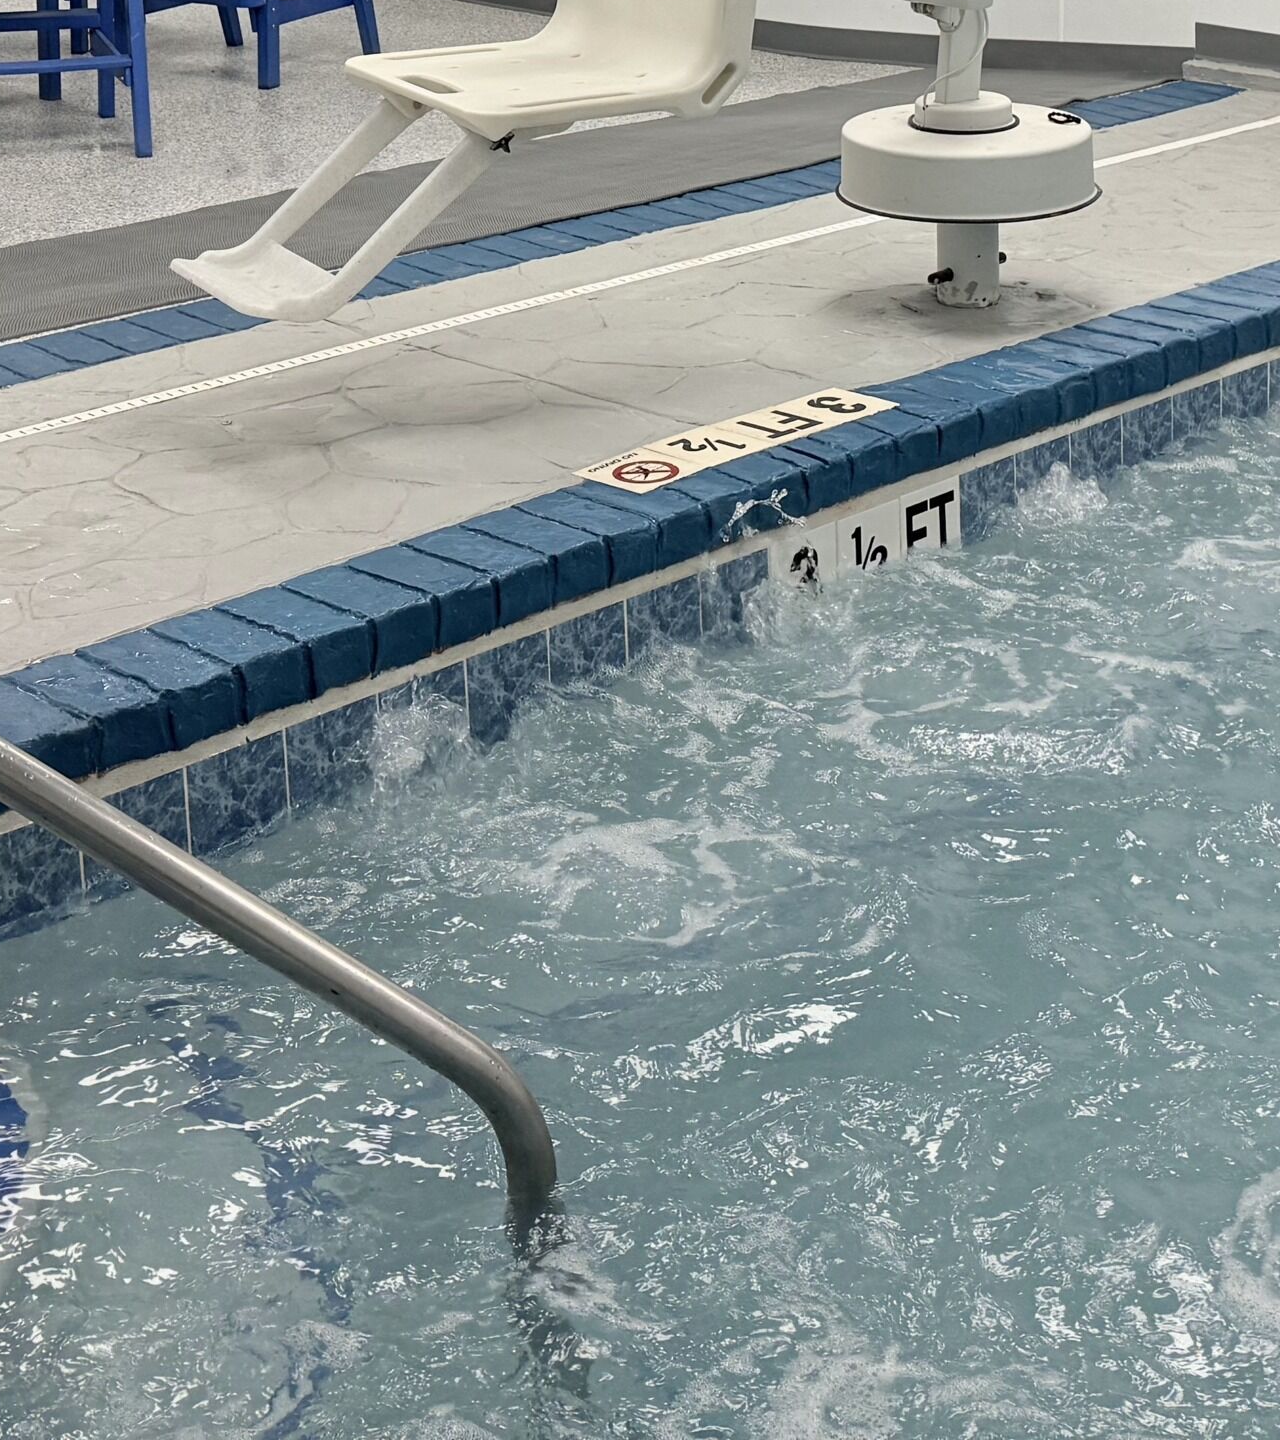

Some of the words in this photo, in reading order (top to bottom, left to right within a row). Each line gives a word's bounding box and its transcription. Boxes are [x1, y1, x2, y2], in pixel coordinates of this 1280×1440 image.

[806, 396, 868, 414] 3
[736, 409, 824, 439] FT
[905, 489, 955, 550] FT
